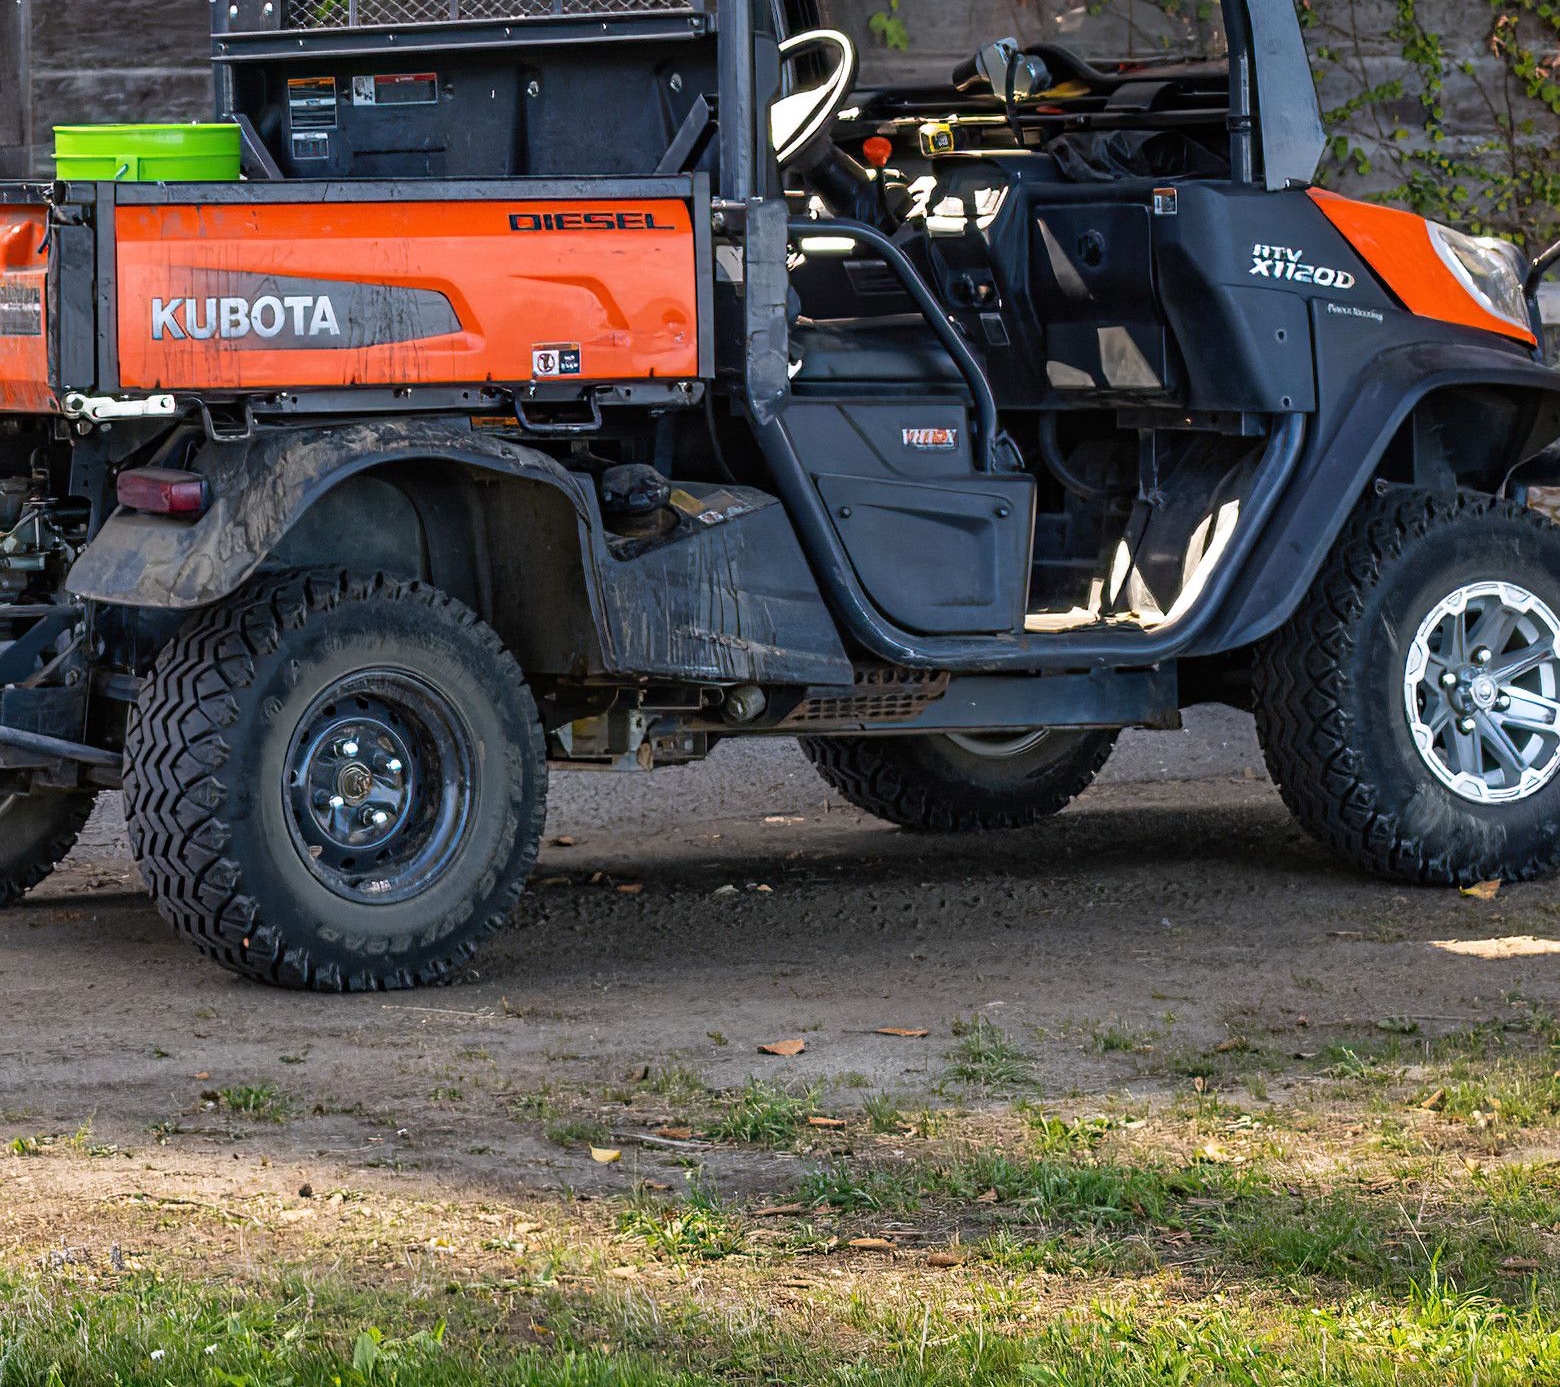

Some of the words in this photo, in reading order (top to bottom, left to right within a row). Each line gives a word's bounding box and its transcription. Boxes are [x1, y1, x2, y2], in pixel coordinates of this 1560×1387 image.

[507, 211, 676, 232] DIESEL
[1252, 243, 1303, 263] RTV
[1248, 257, 1356, 290] X1120D
[150, 294, 341, 341] KUBOTA
